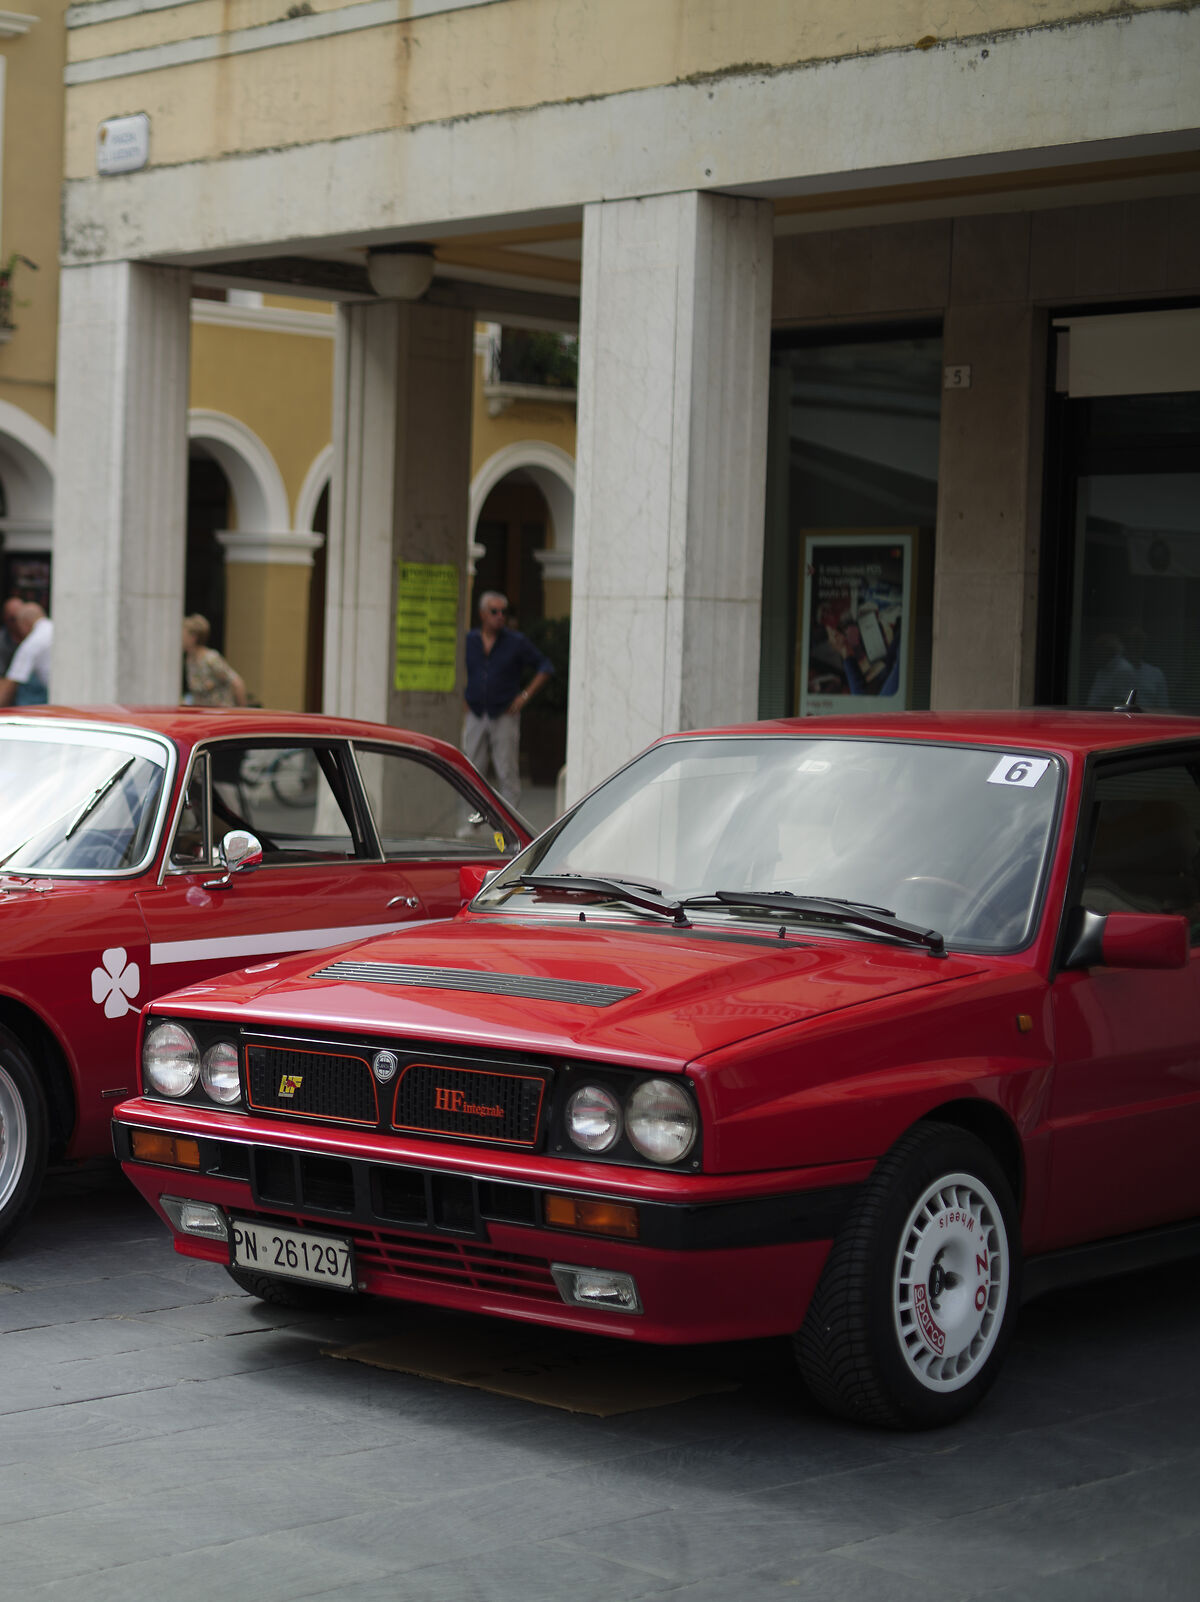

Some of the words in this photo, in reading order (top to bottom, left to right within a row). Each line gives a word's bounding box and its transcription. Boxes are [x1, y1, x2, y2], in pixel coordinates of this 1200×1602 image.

[1004, 760, 1033, 783] 6
[434, 1087, 465, 1113] HF
[463, 1101, 505, 1119] integrale
[939, 1211, 976, 1233] Wheels
[233, 1228, 258, 1261] PN
[272, 1236, 350, 1278] 261297
[915, 1284, 946, 1349] sparco
